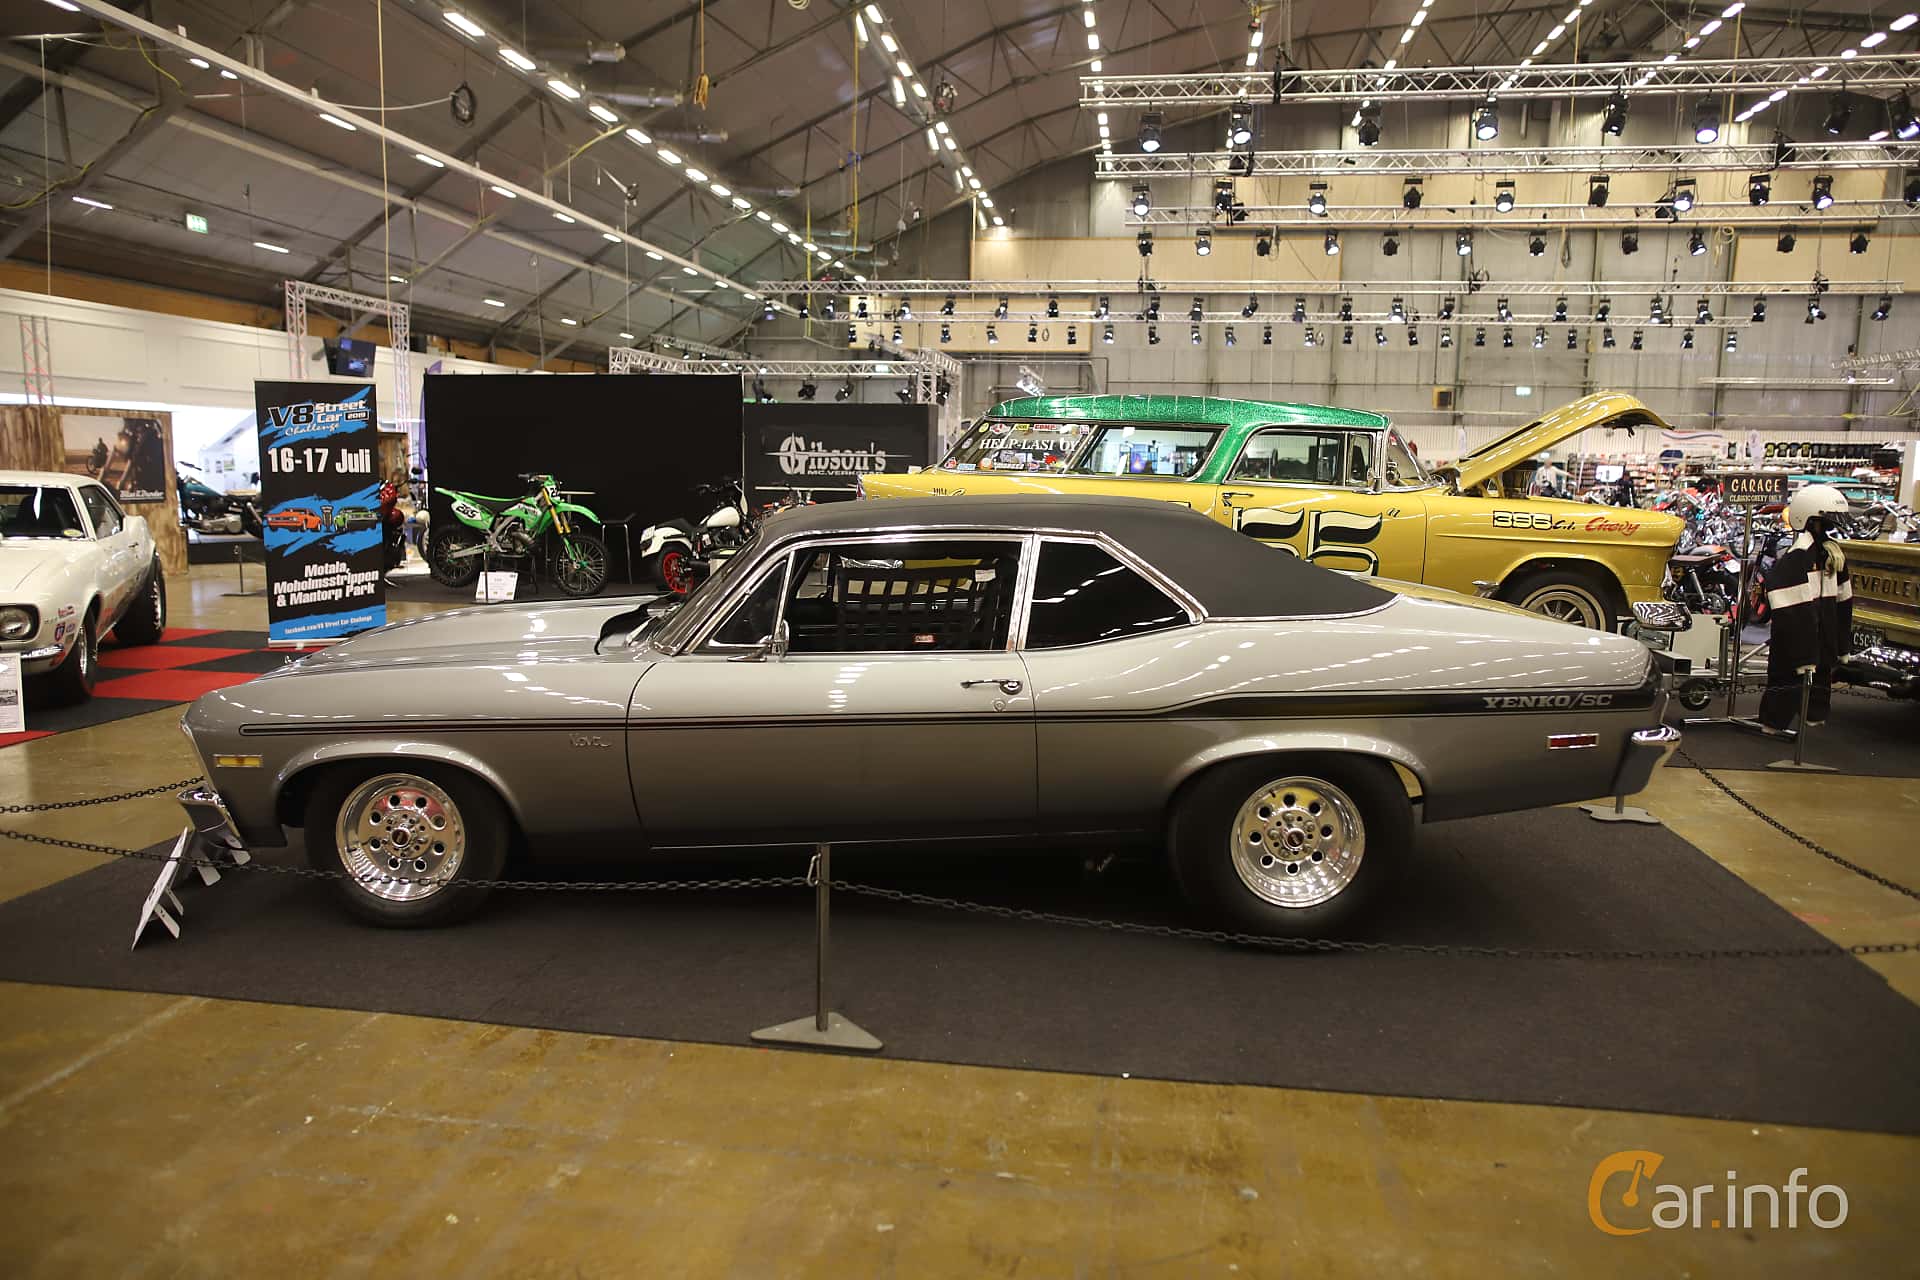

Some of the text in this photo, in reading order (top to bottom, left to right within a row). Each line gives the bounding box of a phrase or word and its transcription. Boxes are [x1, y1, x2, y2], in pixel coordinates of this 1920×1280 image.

[268, 400, 367, 428] V8 Street
[317, 412, 342, 424] Car
[284, 423, 340, 436] Challenge
[268, 447, 371, 473] 16-17 Juli
[779, 434, 887, 475] Gibson's
[1731, 478, 1780, 492] GARAGE
[304, 561, 351, 577] Motala,
[273, 570, 379, 595] Moholmsstrippen
[276, 582, 375, 607] & Mantorp Park
[1482, 693, 1613, 709] YENKO/SC
